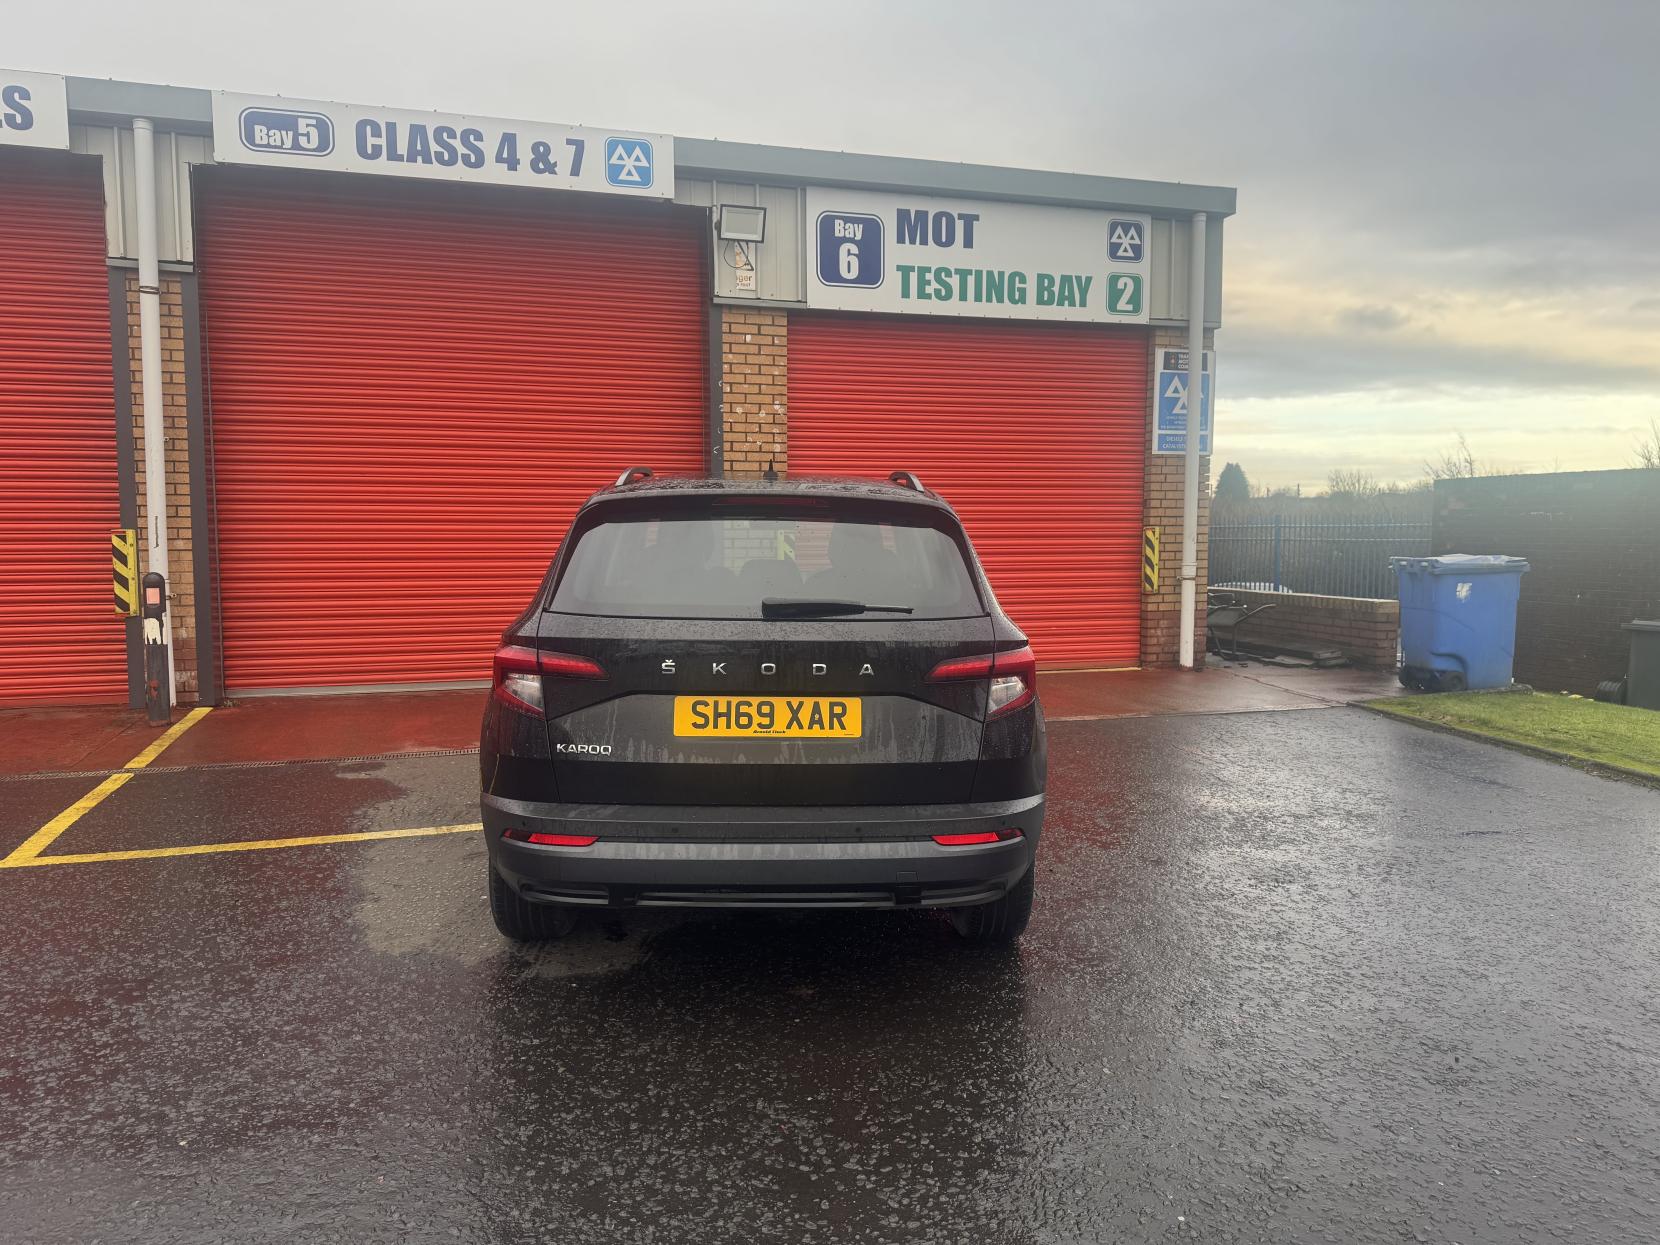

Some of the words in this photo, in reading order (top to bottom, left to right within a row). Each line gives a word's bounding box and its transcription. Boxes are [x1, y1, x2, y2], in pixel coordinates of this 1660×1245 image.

[0, 85, 34, 131] S
[253, 123, 294, 149] Bay
[297, 116, 319, 146] 5
[355, 118, 486, 169] CLASS
[495, 132, 521, 172] 4
[529, 140, 559, 176] &
[564, 138, 586, 178] 7
[834, 219, 863, 241] Bay
[896, 208, 981, 250] MOT
[838, 242, 860, 280] 6
[896, 264, 1028, 306] TESTING
[1035, 272, 1094, 308] BAY
[1116, 276, 1136, 311] 2
[691, 700, 775, 730] SH69
[785, 701, 847, 731] XAR
[556, 743, 612, 756] KAROQ
